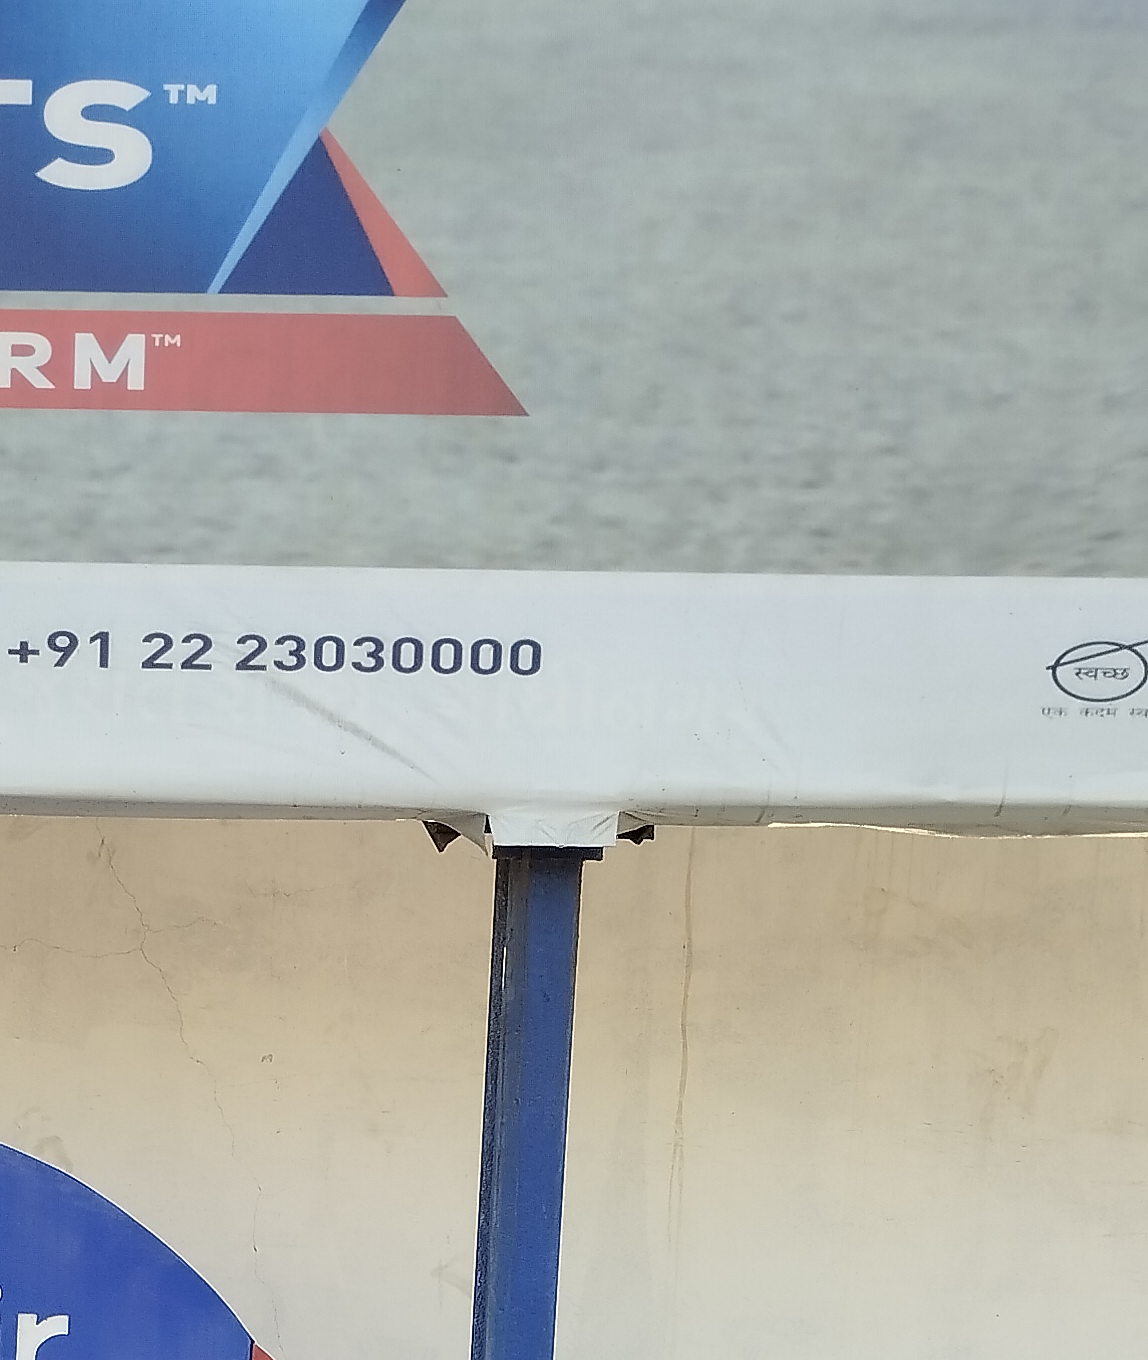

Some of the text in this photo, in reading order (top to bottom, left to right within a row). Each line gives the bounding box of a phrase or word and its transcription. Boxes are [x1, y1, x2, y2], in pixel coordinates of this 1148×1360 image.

[8, 630, 110, 669] +91
[141, 632, 213, 671] 22
[235, 635, 543, 677] 23030000
[1073, 668, 1130, 681] स्वच्छ
